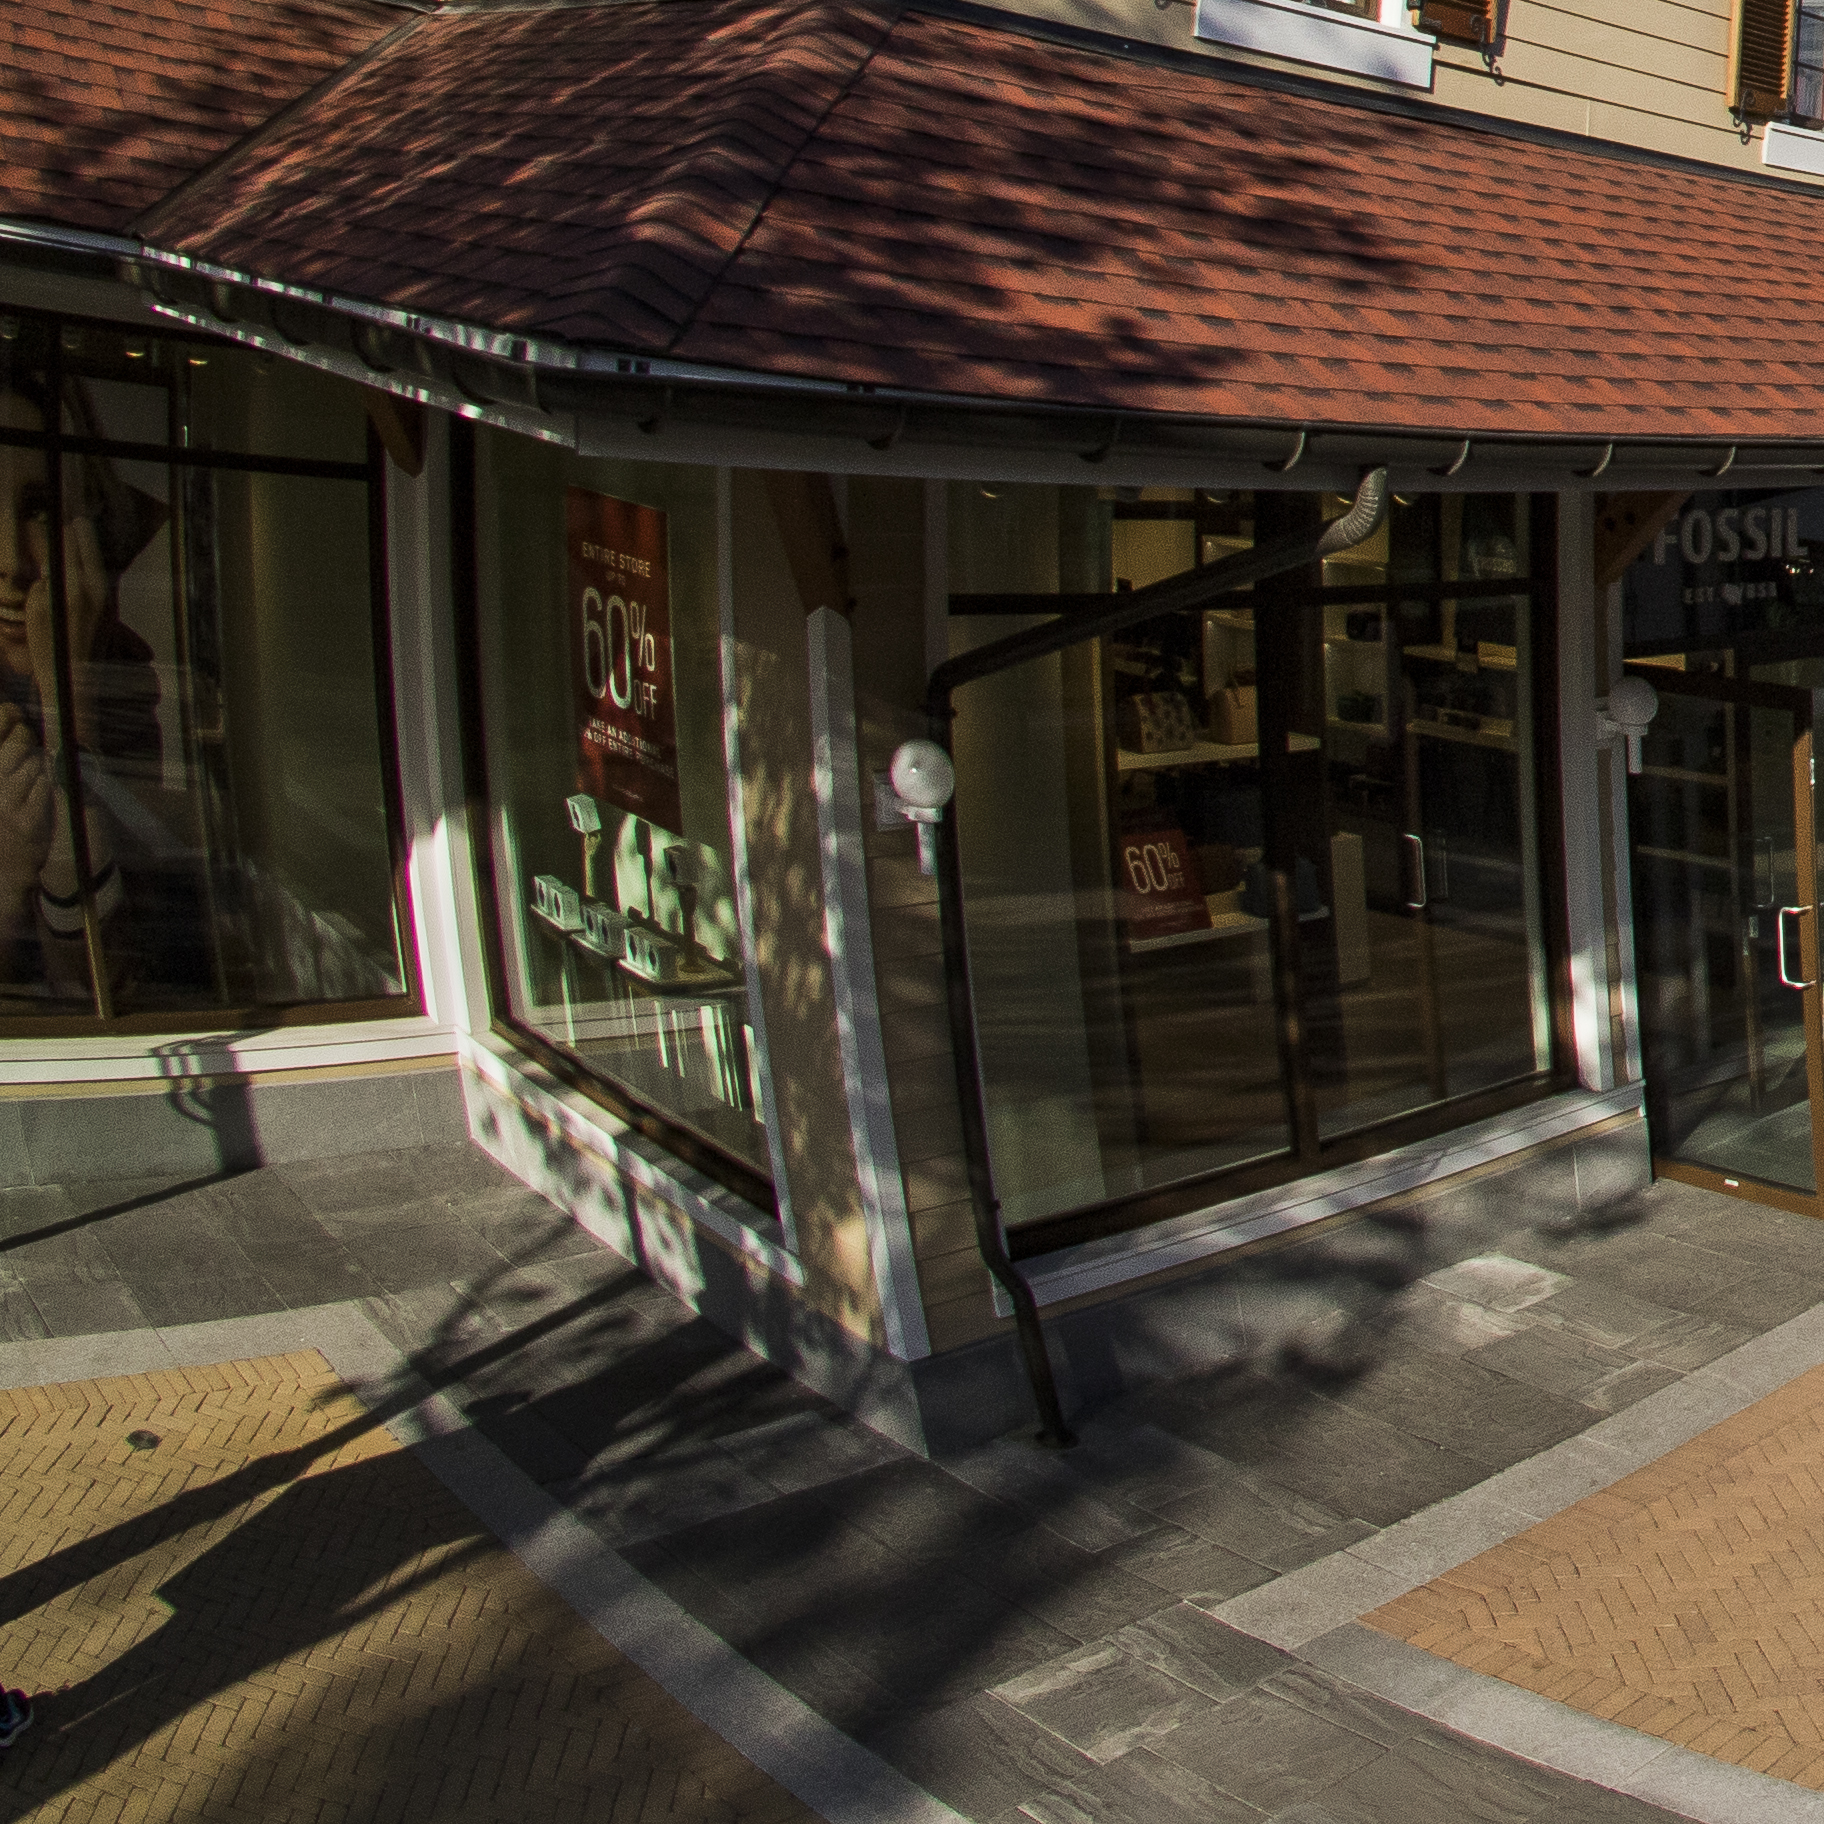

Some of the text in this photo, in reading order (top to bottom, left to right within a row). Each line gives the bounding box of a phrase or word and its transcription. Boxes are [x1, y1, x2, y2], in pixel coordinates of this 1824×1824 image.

[582, 540, 651, 578] ENTIRE STORE
[1653, 507, 1809, 566] FOSSIL
[583, 586, 658, 721] 60% OFF
[1125, 841, 1180, 895] 60%
